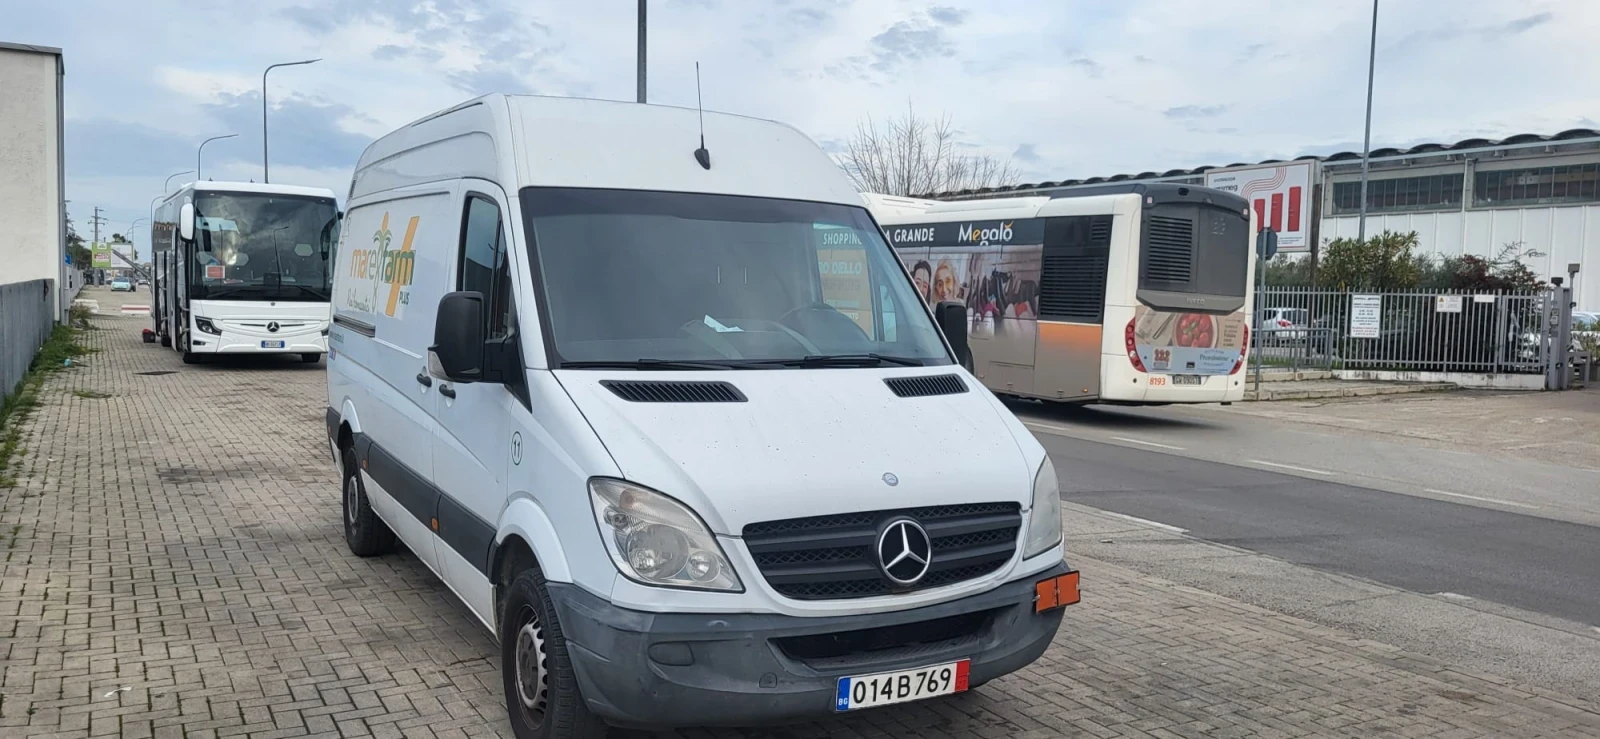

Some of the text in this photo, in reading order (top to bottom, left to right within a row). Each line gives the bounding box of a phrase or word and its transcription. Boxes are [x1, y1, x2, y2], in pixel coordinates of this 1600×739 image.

[894, 228, 935, 242] GRANDE
[832, 262, 862, 275] DELLO
[399, 291, 410, 305] PLUS
[1150, 377, 1166, 385] 8193
[513, 439, 521, 459] 11
[853, 667, 952, 704] 014B769
[838, 697, 848, 706] BG
